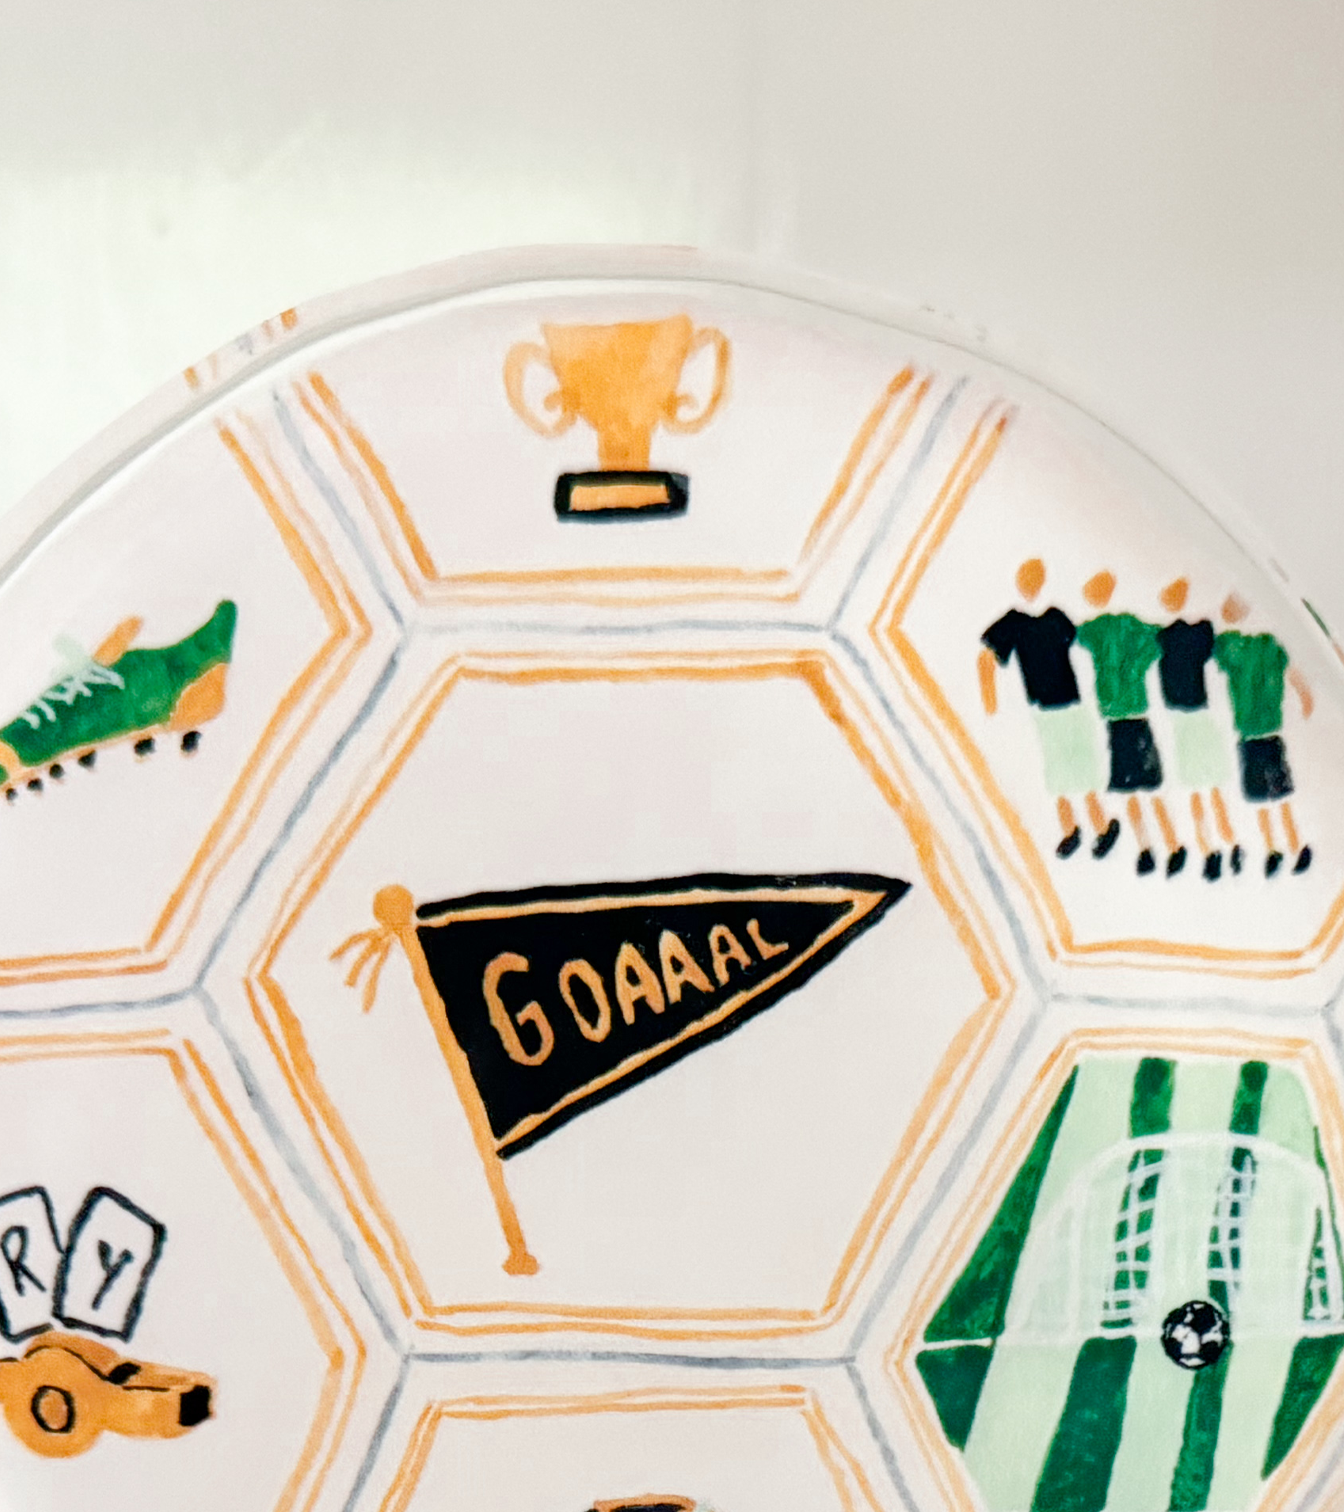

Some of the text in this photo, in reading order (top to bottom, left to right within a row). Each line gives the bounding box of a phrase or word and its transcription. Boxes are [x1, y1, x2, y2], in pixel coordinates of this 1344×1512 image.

[482, 918, 789, 1067] GOAAAL
[0, 1225, 47, 1296] R
[96, 1239, 135, 1310] Y
